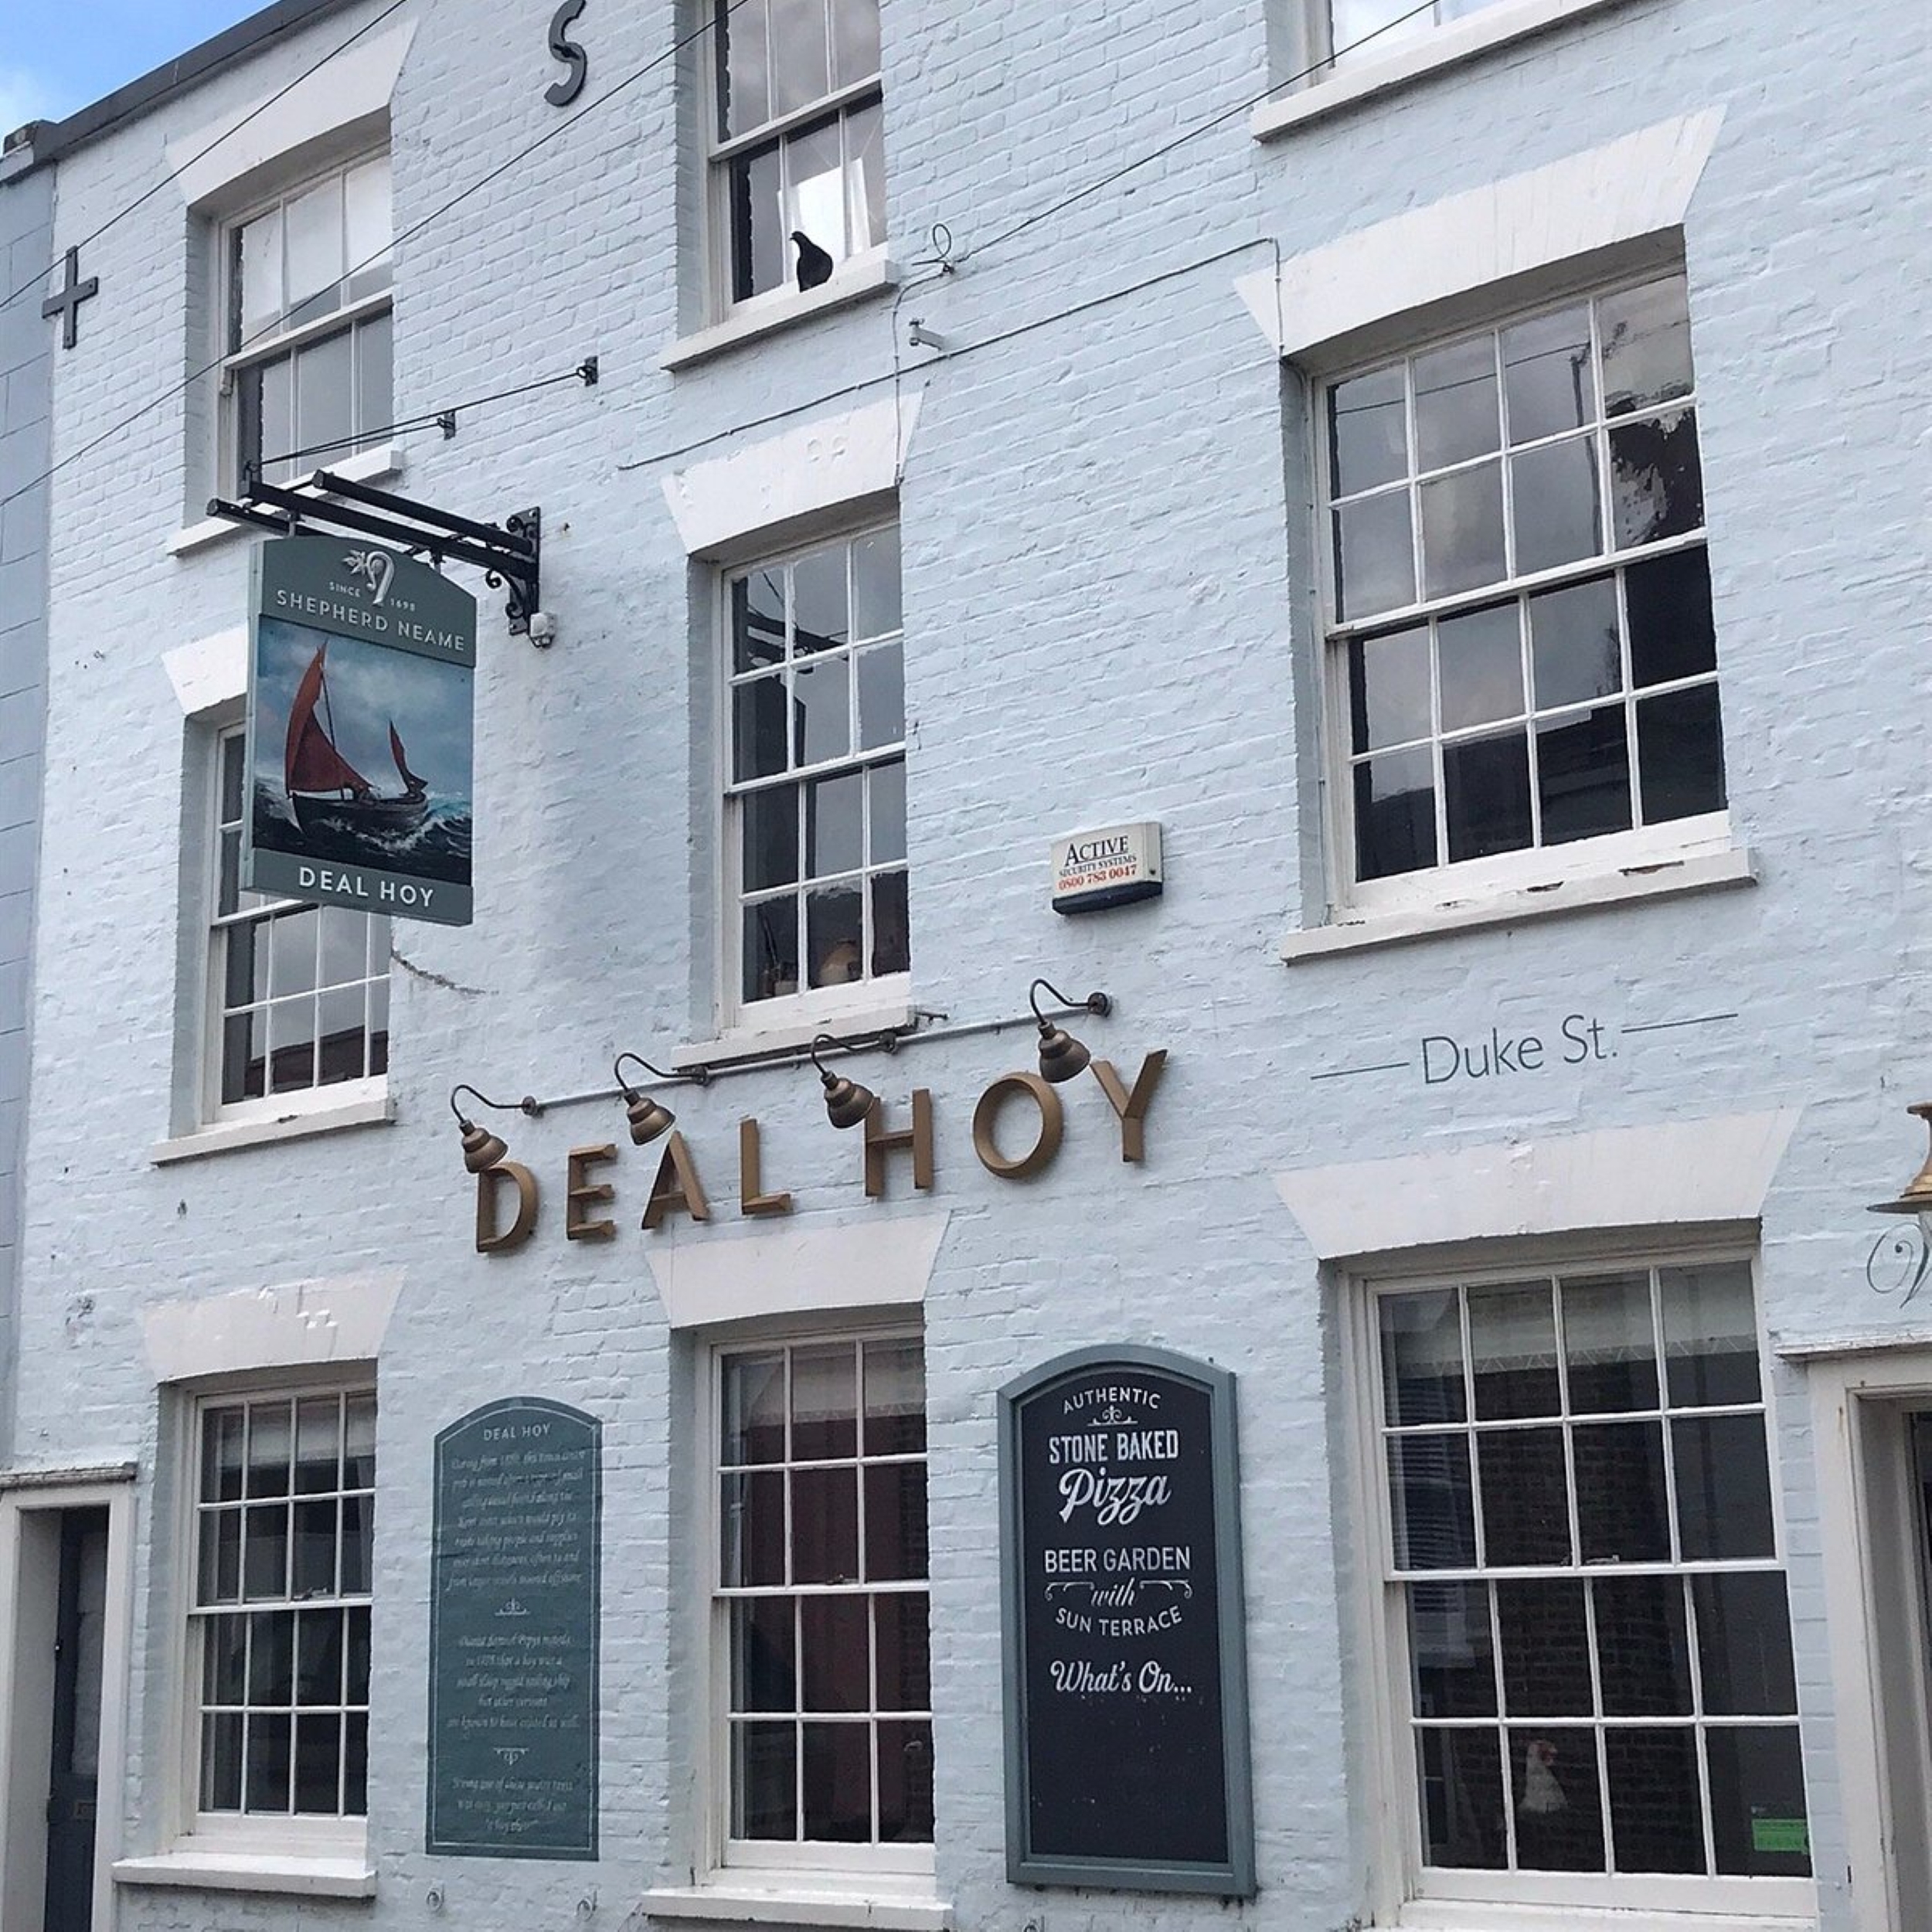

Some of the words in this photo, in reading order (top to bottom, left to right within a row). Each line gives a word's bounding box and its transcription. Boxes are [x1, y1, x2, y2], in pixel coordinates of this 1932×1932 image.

[329, 581, 361, 597] SINCE
[390, 598, 416, 612] 1698
[277, 590, 389, 631] SHEPHERD
[397, 620, 465, 651] NEAME
[1059, 862, 1097, 878] SECURITY
[1098, 854, 1138, 870] SYSTEMS
[299, 866, 369, 897] DEAL
[379, 880, 434, 907] HOY
[1059, 876, 1083, 890] 0800
[1422, 1027, 1543, 1083] Duke
[1561, 1014, 1618, 1063] St.
[475, 1115, 793, 1254] DEAL
[862, 1048, 1169, 1198] HOY
[1063, 1386, 1161, 1415] AUTHENTIC
[483, 1427, 517, 1441] DEAL
[522, 1423, 552, 1438] HOY
[1049, 1433, 1108, 1464] STONE
[1117, 1430, 1179, 1461] BAKED
[1059, 1467, 1172, 1526] Pizza
[1045, 1549, 1097, 1573] BEER
[1104, 1546, 1190, 1571] GARDEN
[1090, 1577, 1135, 1607] with
[1056, 1607, 1091, 1633] SUN
[1098, 1605, 1182, 1636] TERRACE
[1050, 1661, 1132, 1692] What's
[1138, 1660, 1192, 1692] On...
